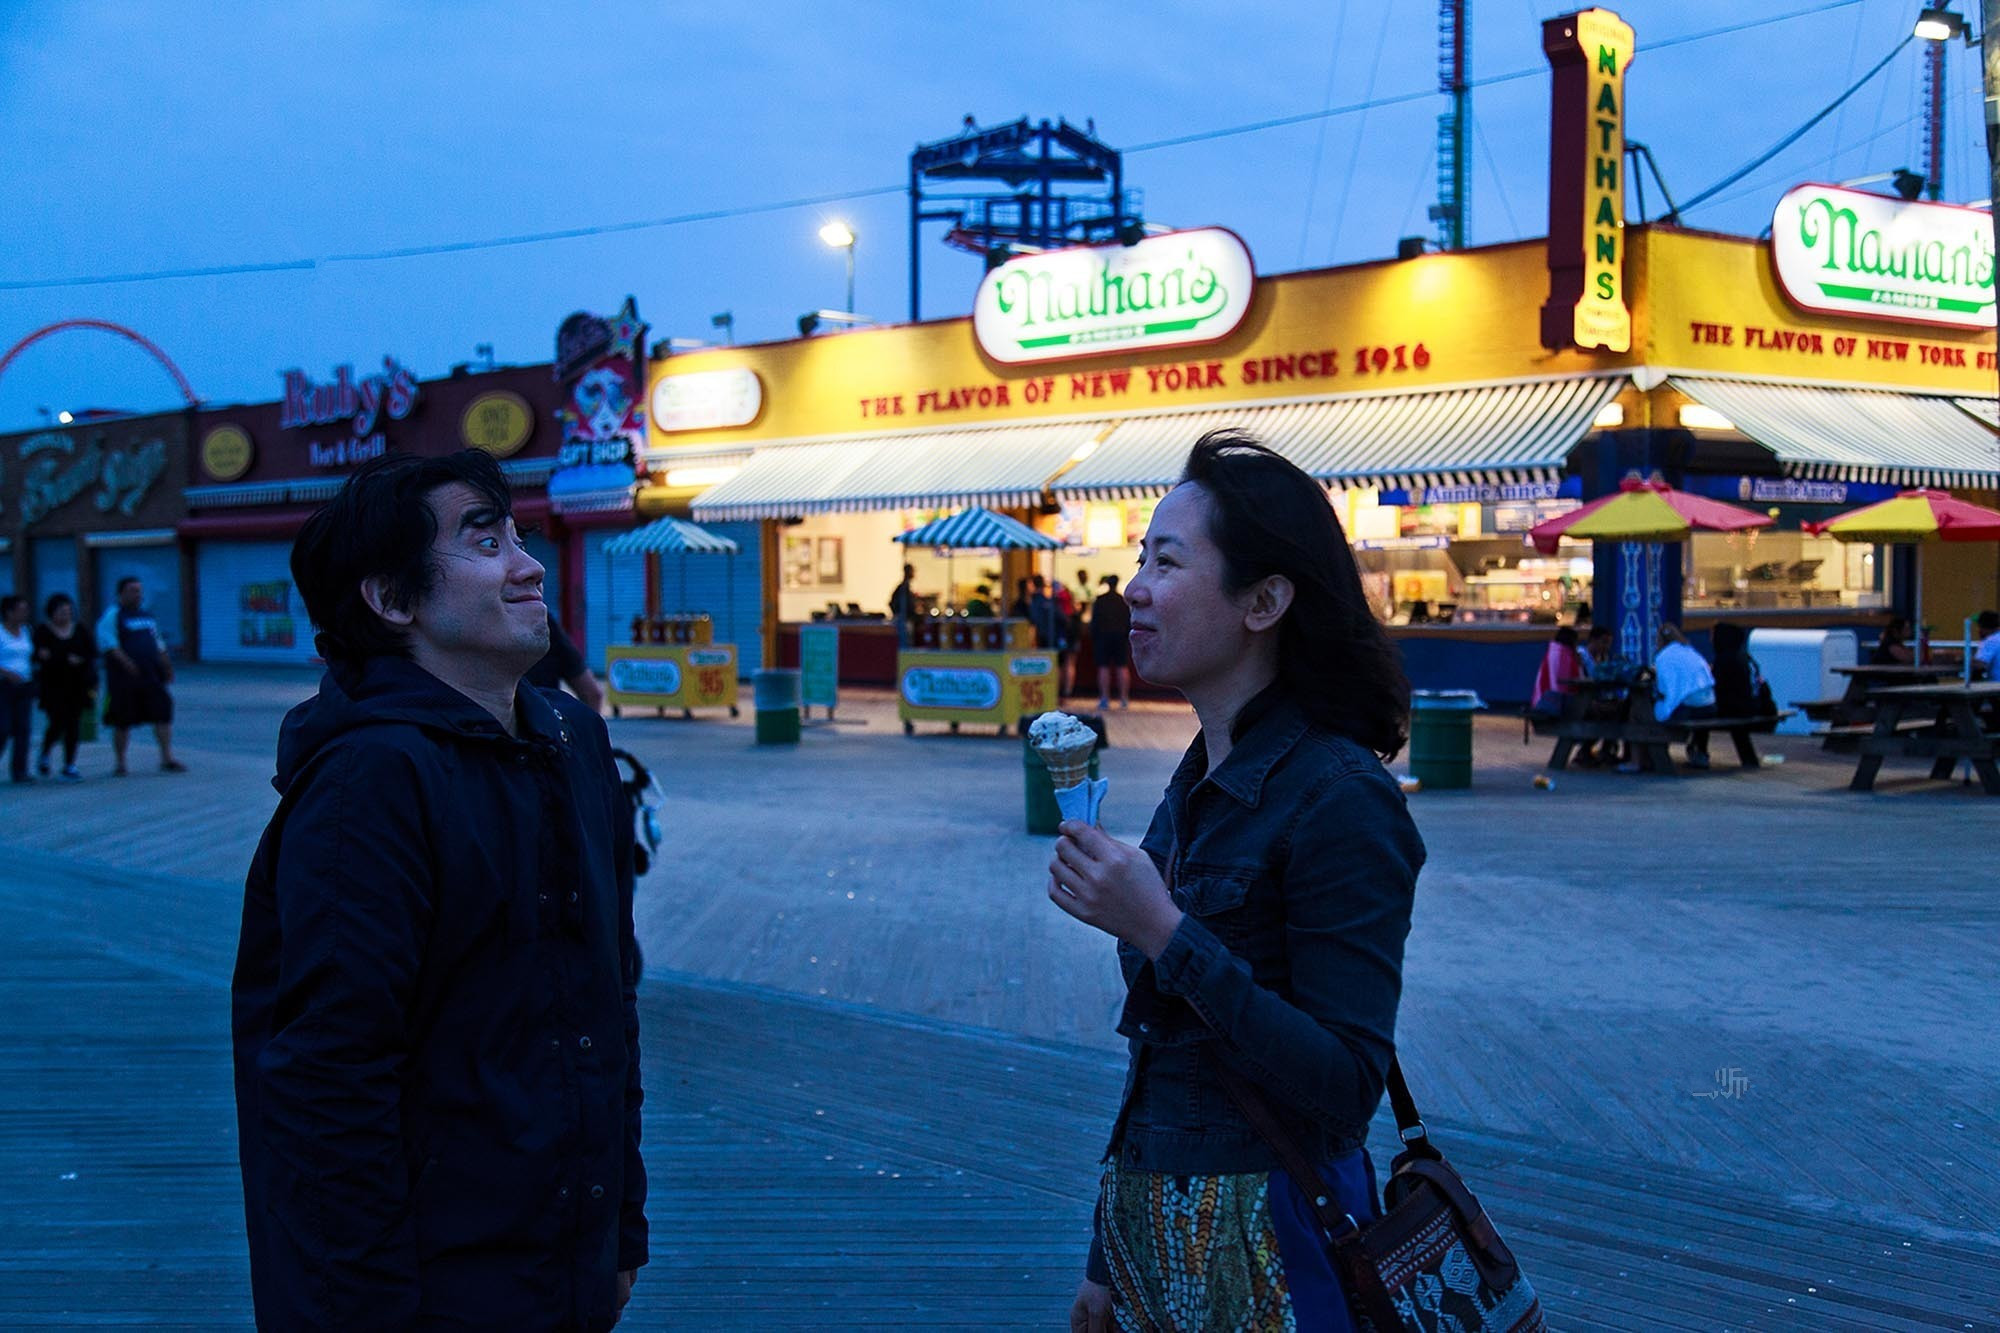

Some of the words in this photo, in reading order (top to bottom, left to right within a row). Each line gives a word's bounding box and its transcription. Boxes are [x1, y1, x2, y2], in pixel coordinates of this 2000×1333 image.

[1596, 44, 1617, 300] NATHANS
[996, 249, 1217, 326] Nathan's
[860, 395, 904, 418] THE
[917, 382, 1011, 414] FLAVOR
[1024, 379, 1054, 403] OF
[1071, 366, 1132, 400] NEW
[1147, 361, 1226, 393] YORK
[1241, 350, 1339, 386] SINCE
[1355, 343, 1430, 375] 1916
[1691, 321, 1733, 346] THE
[1745, 327, 1824, 354] FLAVOR
[1834, 336, 1857, 358] OF
[1867, 338, 1909, 361] NEW
[1918, 344, 1966, 367] YORK
[281, 356, 416, 437] Ruby's
[1431, 482, 1490, 502] Auntie
